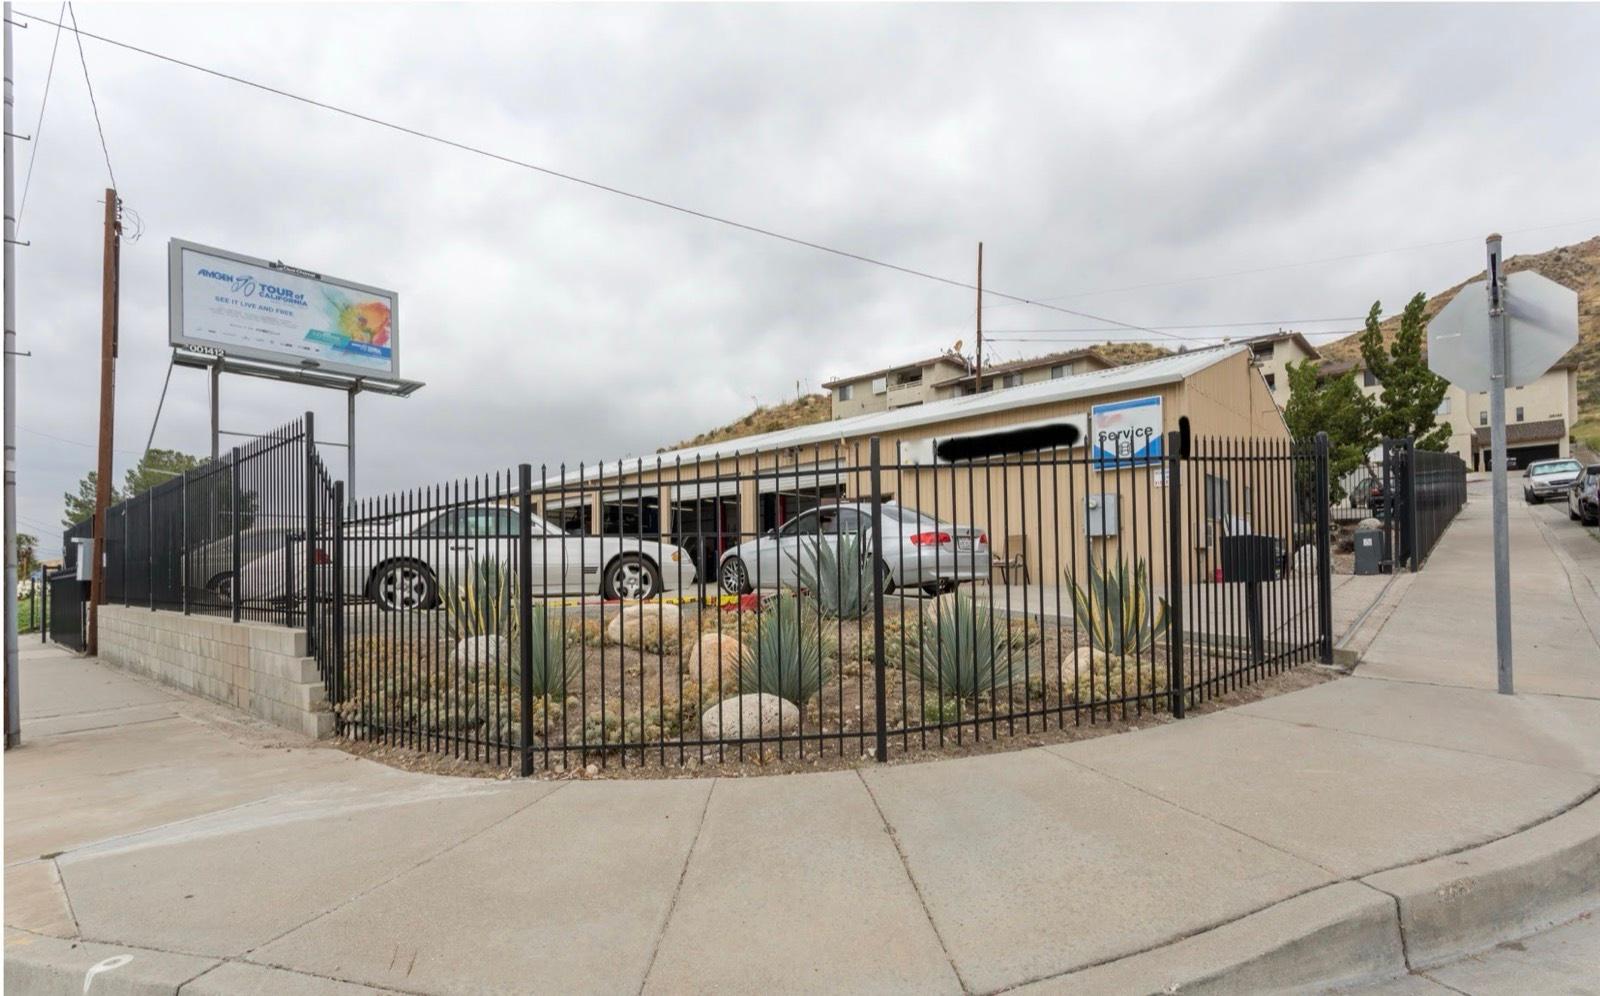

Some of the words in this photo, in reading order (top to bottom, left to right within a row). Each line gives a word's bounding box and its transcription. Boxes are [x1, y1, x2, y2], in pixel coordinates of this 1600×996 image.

[197, 268, 233, 282] AMGEN
[258, 283, 294, 297] TOUR
[215, 296, 228, 304] SEE
[240, 301, 256, 309] LIVE
[275, 308, 293, 316] FREE
[258, 291, 308, 306] CALIFORNIA
[1099, 426, 1153, 441] Service
